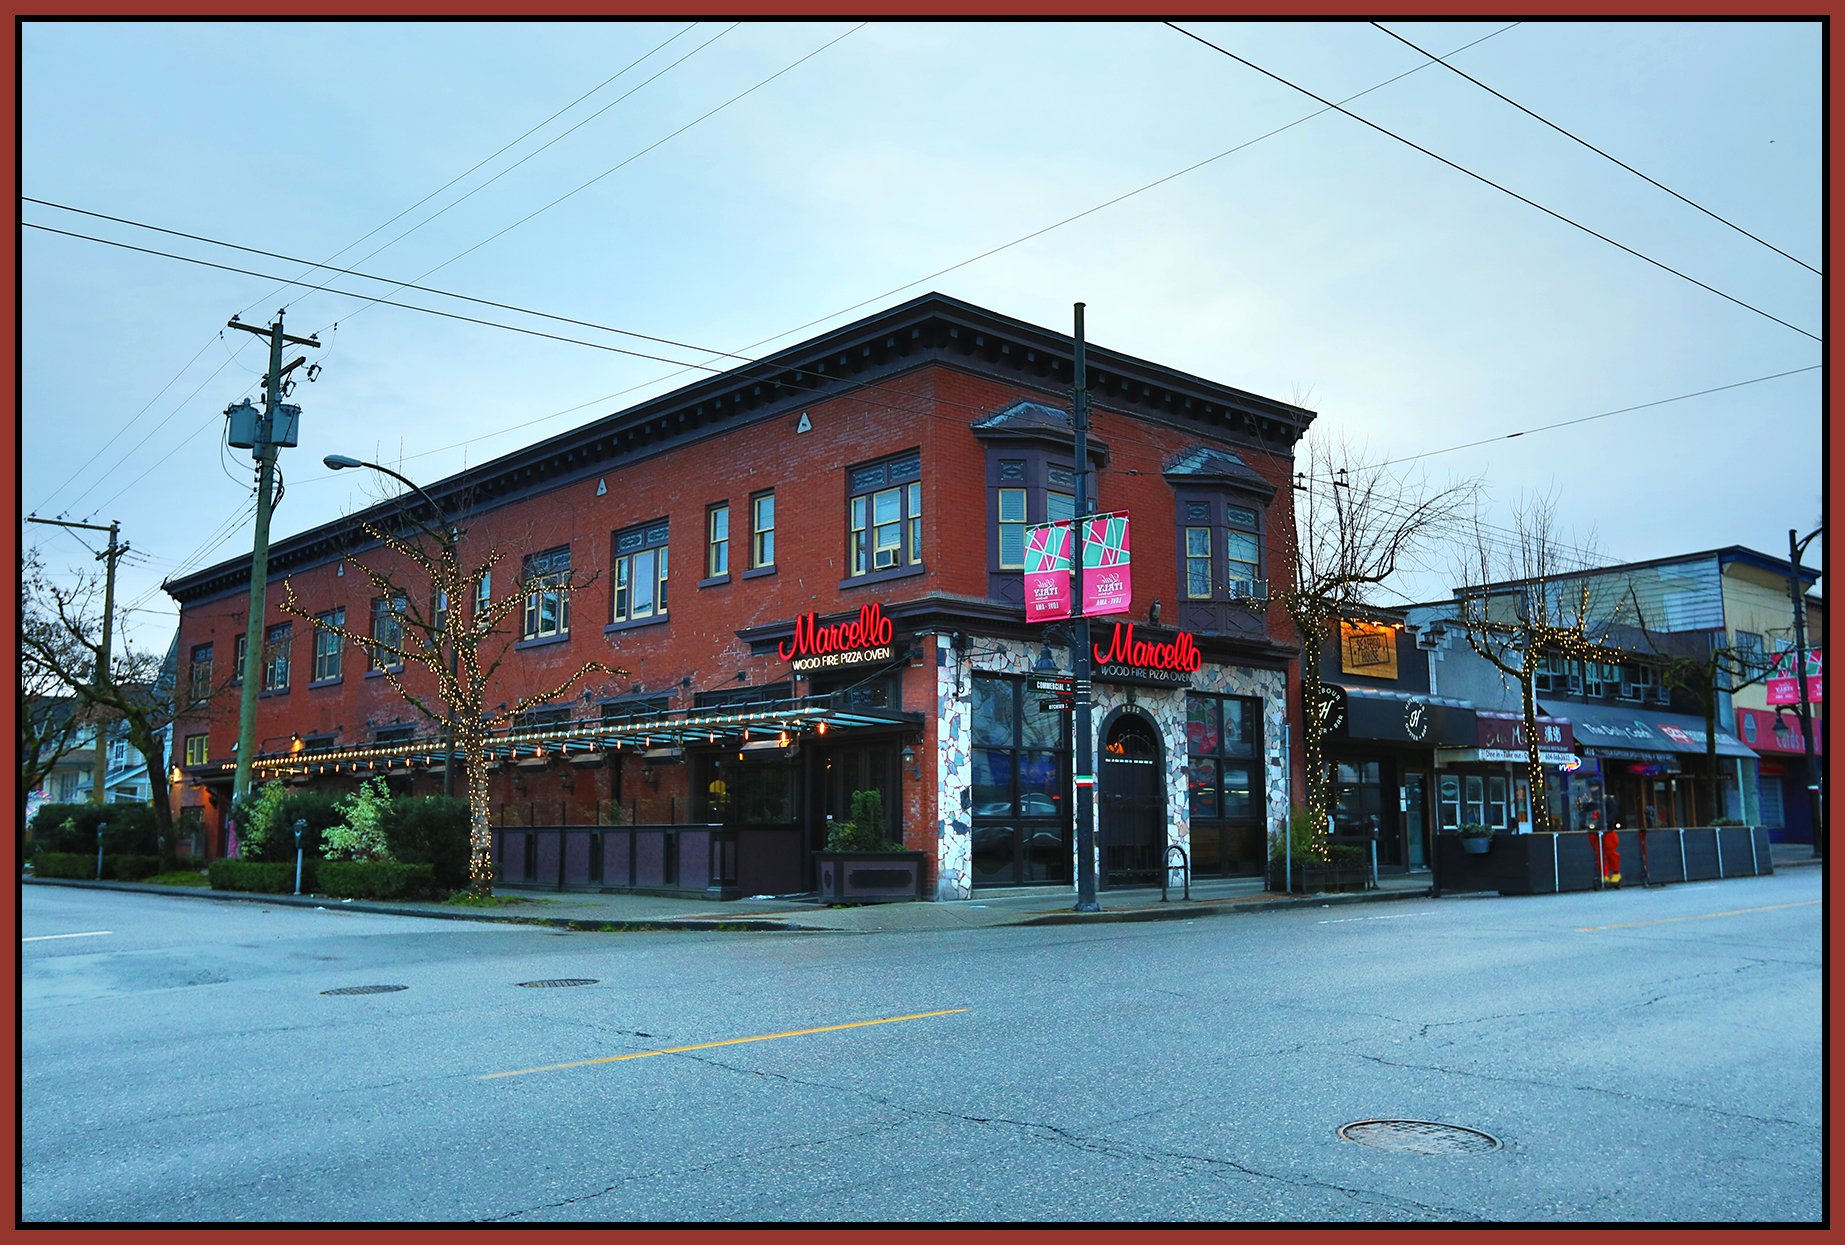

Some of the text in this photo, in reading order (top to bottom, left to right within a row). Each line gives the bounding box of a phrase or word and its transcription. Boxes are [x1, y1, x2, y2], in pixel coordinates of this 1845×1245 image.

[778, 602, 892, 661] Marcello
[1093, 622, 1202, 672] Marcello
[792, 647, 890, 671] WOOD FIRE PIZZA OVEN
[1101, 664, 1192, 683] WOOD FIRE PIZZA OVEN
[1036, 681, 1065, 691] COMMERCIAL
[1333, 714, 1344, 729] BAR
[1582, 723, 1605, 735] The
